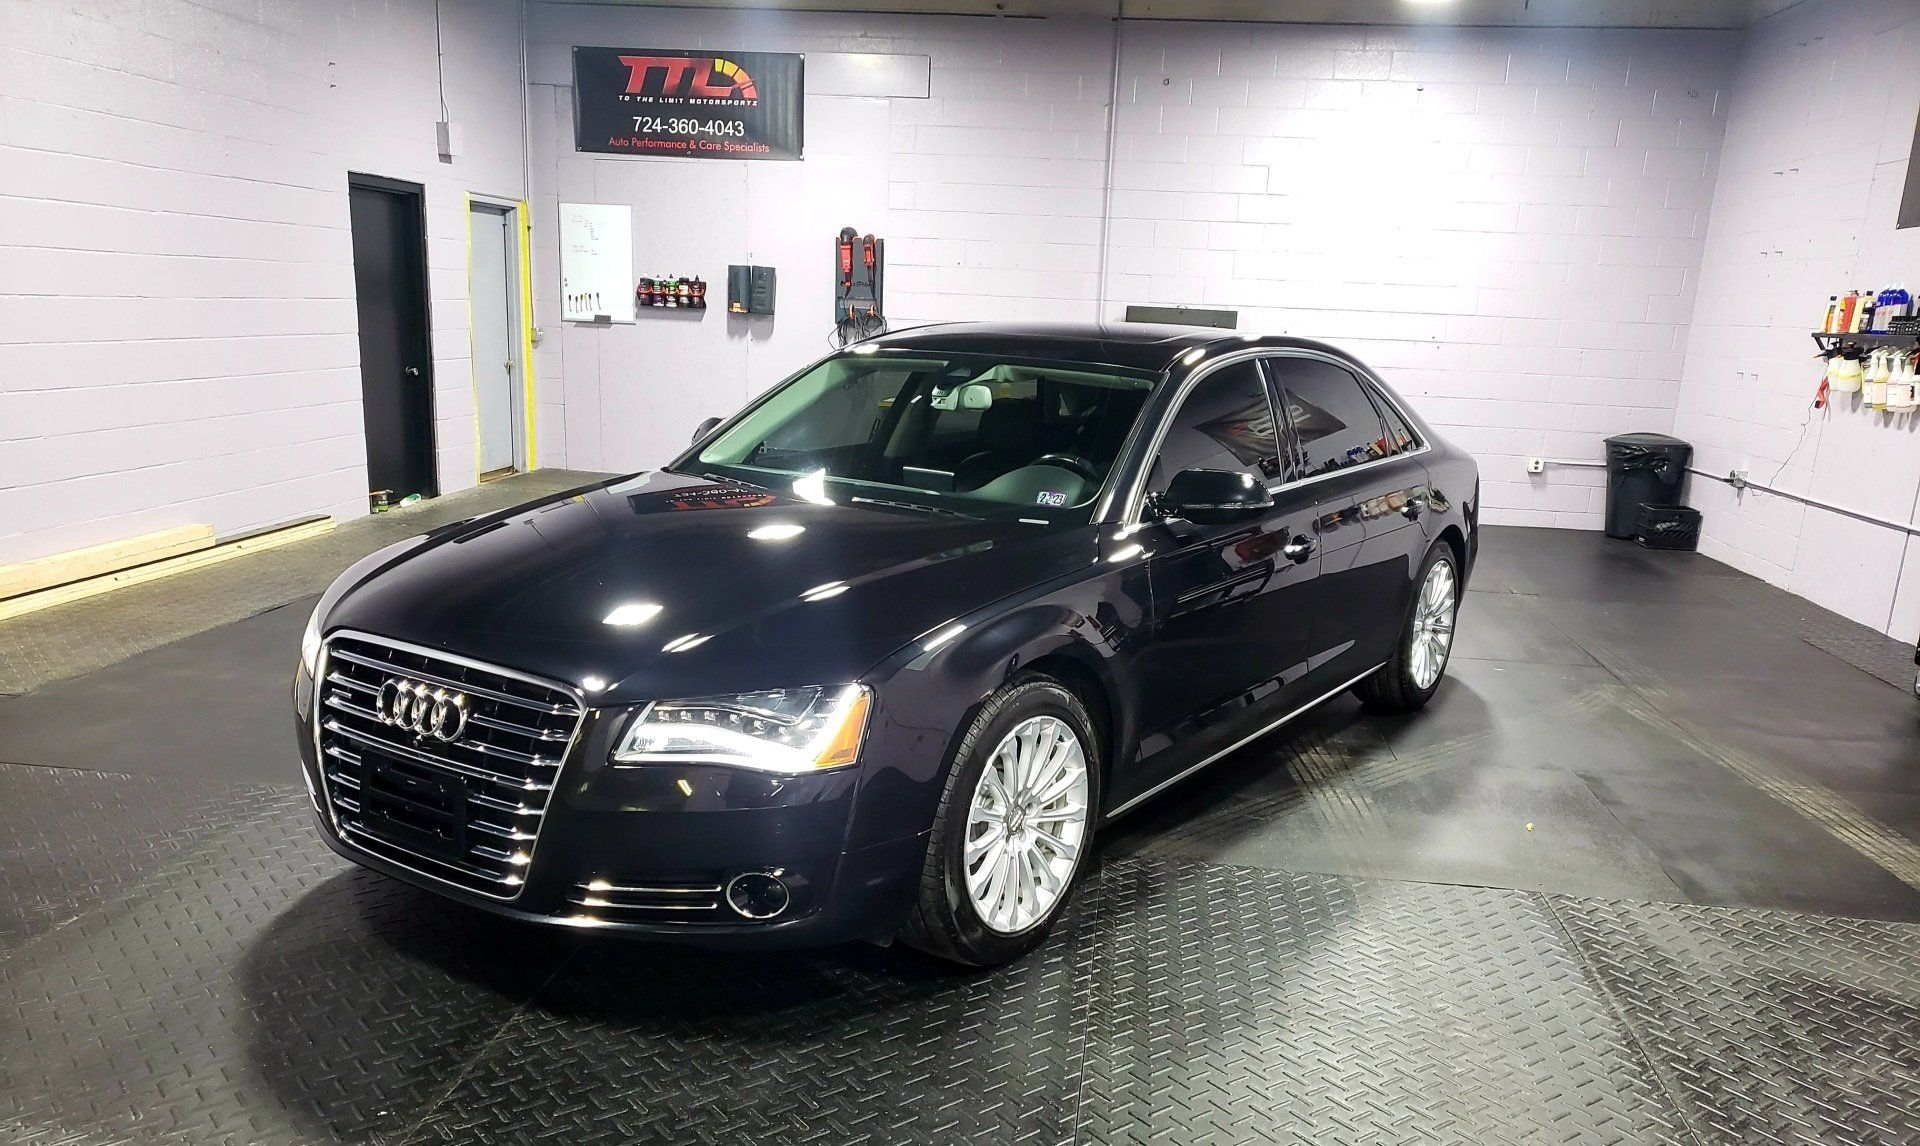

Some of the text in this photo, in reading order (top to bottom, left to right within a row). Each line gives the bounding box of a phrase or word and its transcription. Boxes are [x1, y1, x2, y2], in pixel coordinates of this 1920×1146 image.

[689, 98, 758, 106] MOTORSPORTZ
[632, 116, 745, 137] 724-360-4043
[608, 137, 770, 153] Auto Performance & Care Specialists
